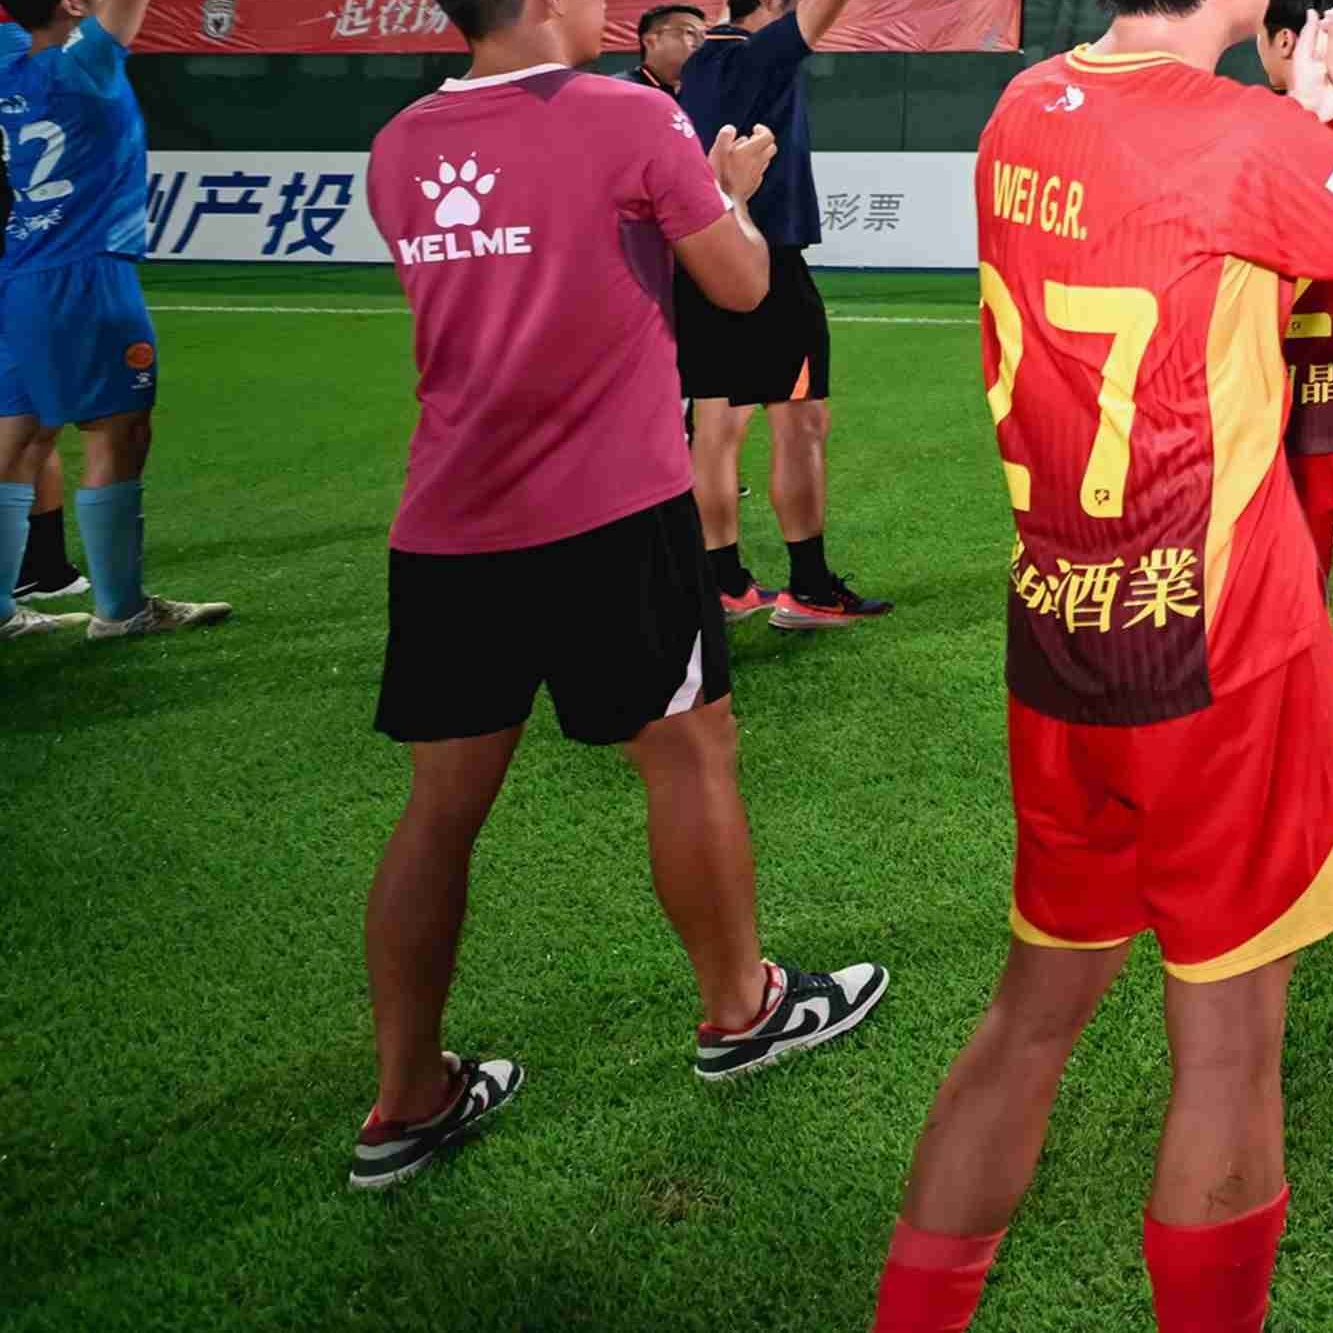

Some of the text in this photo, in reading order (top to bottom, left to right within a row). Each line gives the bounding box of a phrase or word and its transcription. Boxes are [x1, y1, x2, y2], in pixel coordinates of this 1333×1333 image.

[821, 193, 905, 232] 彩票
[993, 159, 1088, 241] WEI G.R.
[398, 224, 532, 266] KELME
[980, 259, 1159, 519] 27
